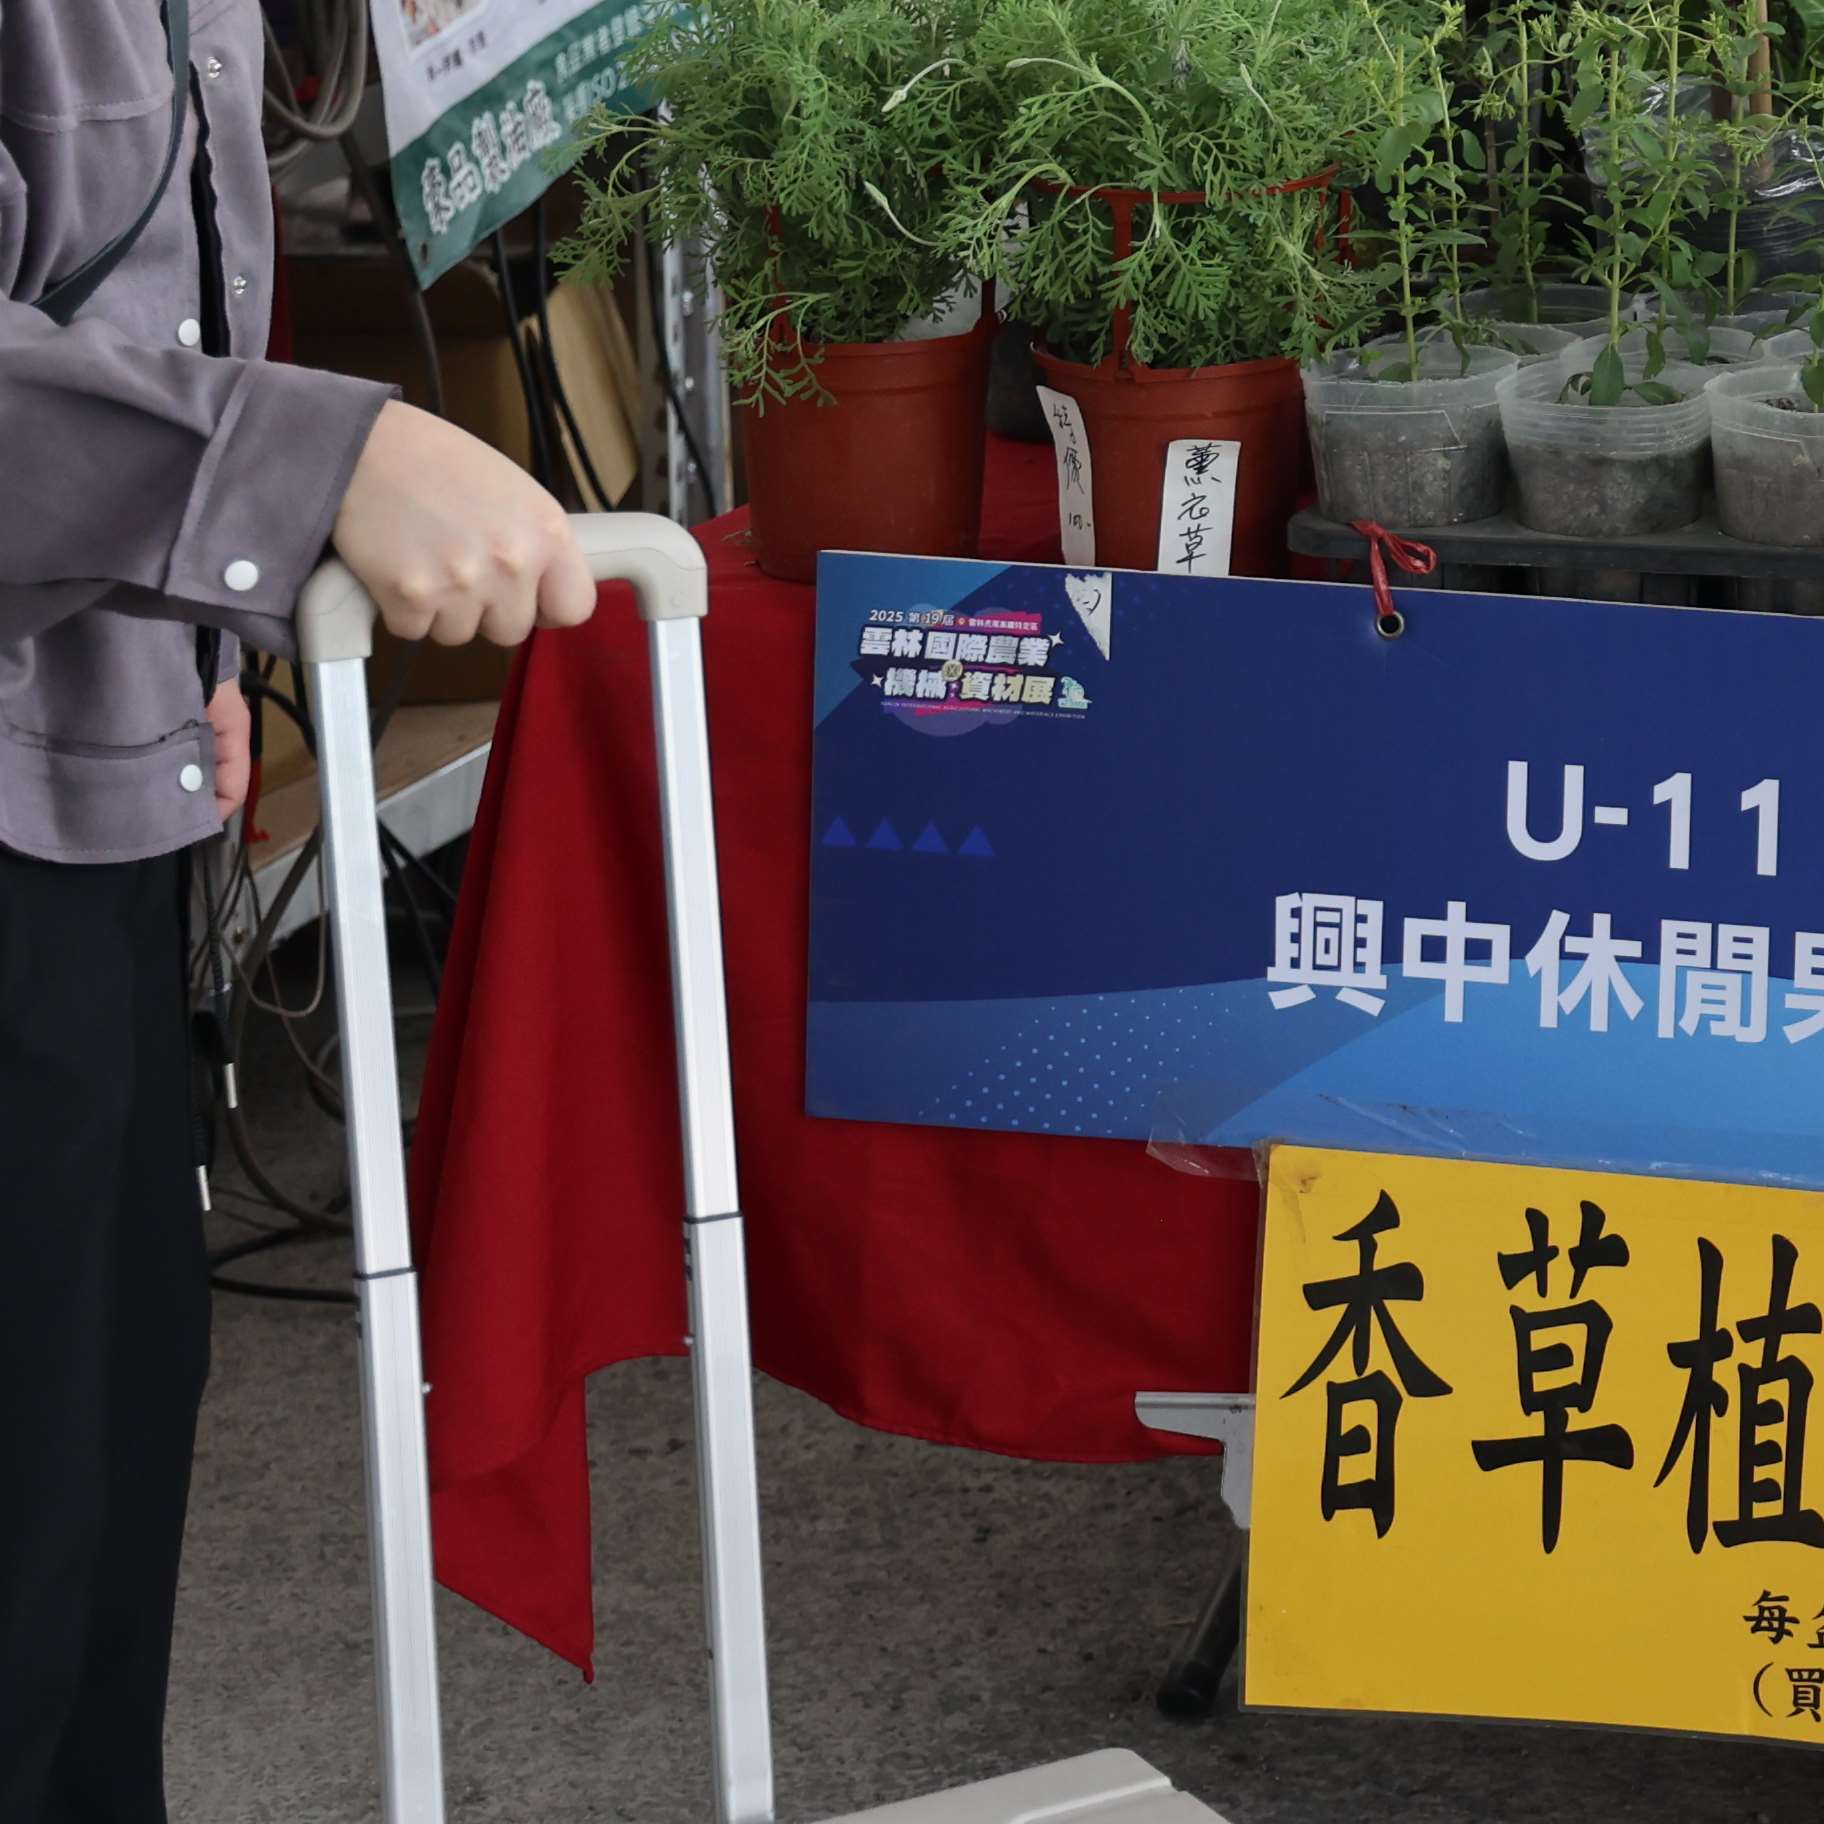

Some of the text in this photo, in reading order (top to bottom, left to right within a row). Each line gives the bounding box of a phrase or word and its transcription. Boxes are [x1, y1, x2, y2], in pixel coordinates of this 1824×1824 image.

[869, 609, 904, 623] 2025
[859, 626, 1051, 667] 雲林國際農業
[1506, 760, 1780, 876] U-11
